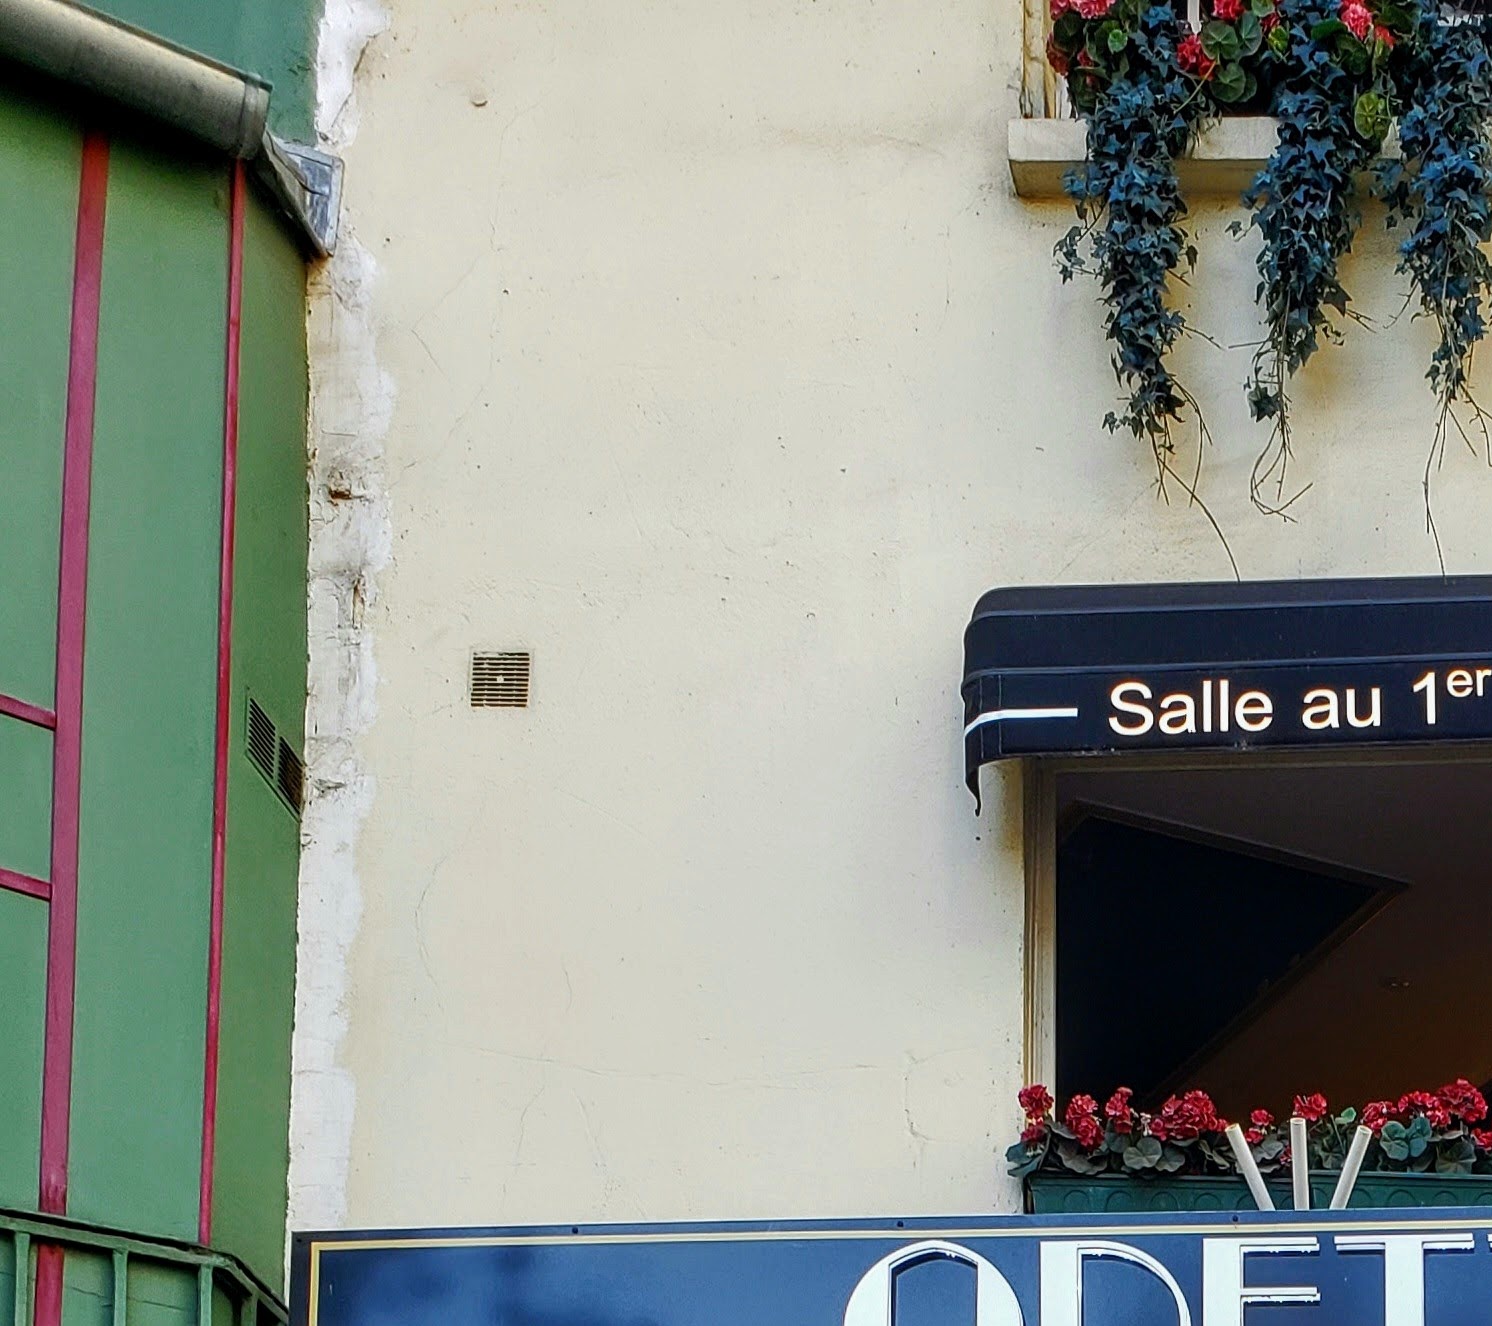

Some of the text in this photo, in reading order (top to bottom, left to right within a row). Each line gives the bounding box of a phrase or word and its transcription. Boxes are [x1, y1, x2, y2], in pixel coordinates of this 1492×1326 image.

[1107, 667, 1492, 737] Salle au 1er
